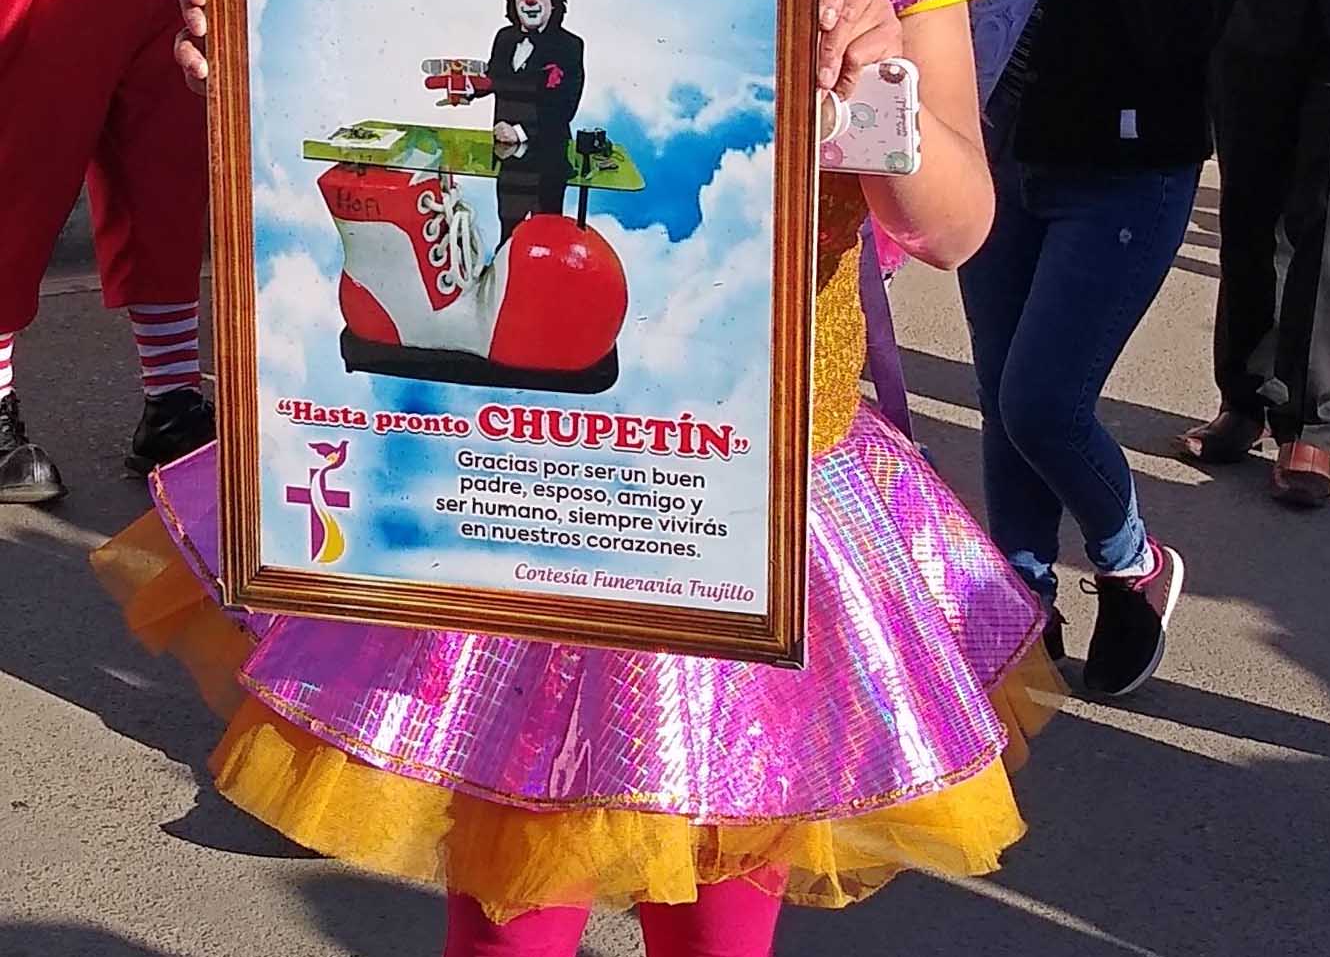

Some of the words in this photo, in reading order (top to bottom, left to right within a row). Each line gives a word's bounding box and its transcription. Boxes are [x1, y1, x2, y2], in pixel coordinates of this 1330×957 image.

[375, 410, 471, 436] pronto
[457, 450, 538, 474] Gracias
[544, 460, 580, 481] por
[584, 465, 616, 480] ser
[620, 467, 649, 484] un
[651, 466, 706, 489] buen
[460, 474, 529, 498] padre,
[533, 483, 613, 506] esposo,
[617, 489, 686, 514] amigo
[690, 497, 704, 516] y
[436, 496, 467, 513] ser
[471, 497, 563, 524] humano,
[568, 508, 653, 532] siempre
[657, 514, 728, 538] vivirás
[461, 522, 487, 538] en
[491, 525, 581, 547] nuestros
[587, 532, 702, 558] corazones.
[514, 562, 588, 588] Cortesía
[593, 570, 684, 596] Funeraria
[688, 579, 755, 603] Trujillo
